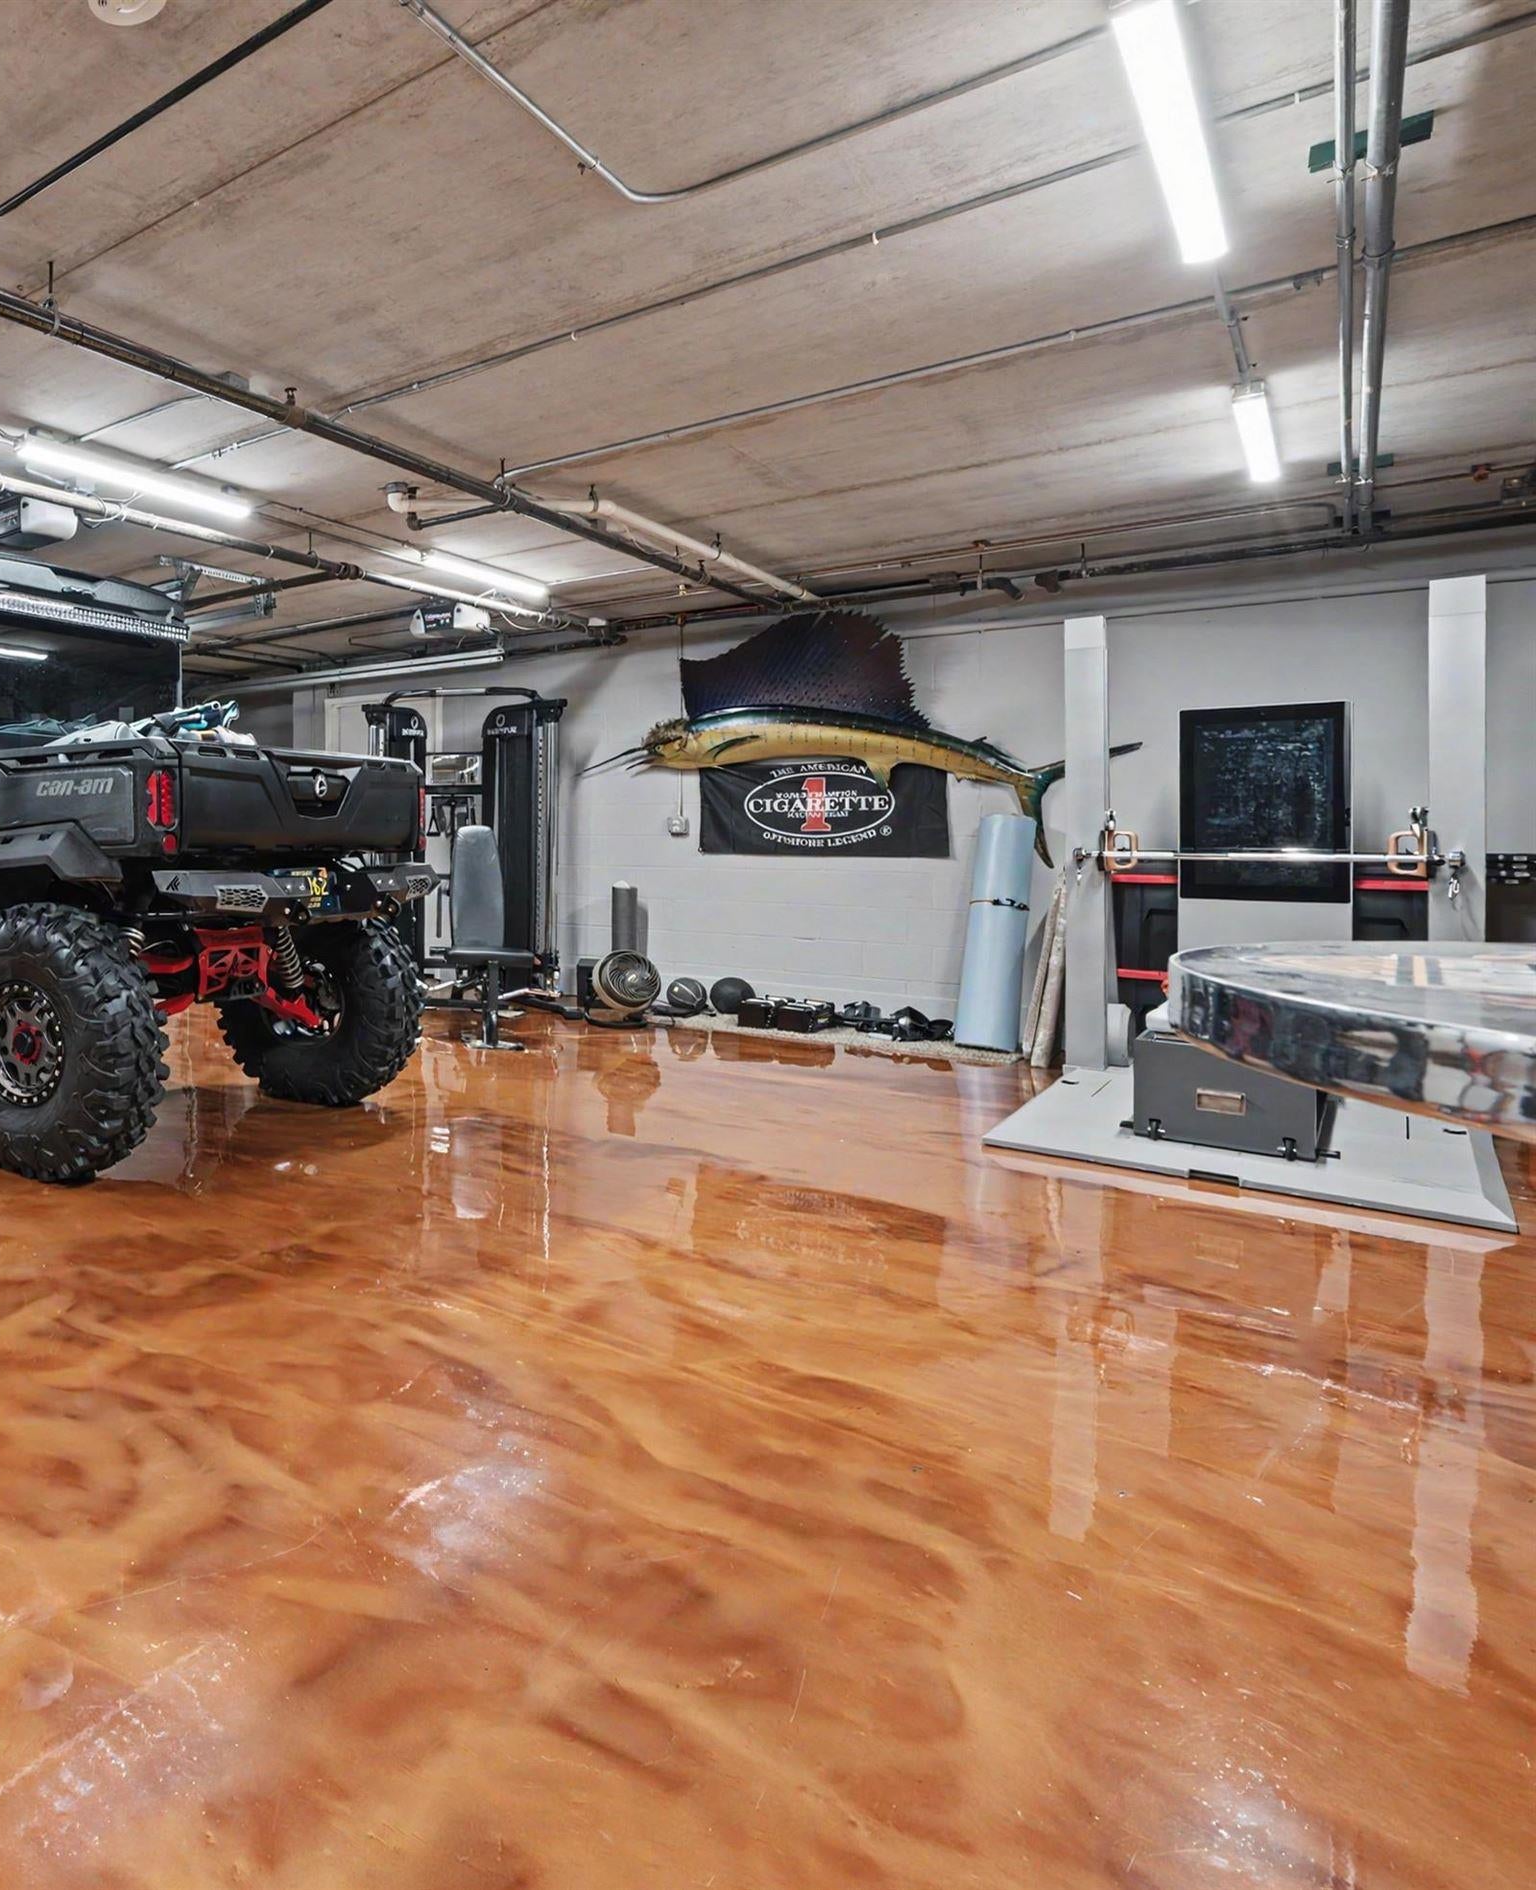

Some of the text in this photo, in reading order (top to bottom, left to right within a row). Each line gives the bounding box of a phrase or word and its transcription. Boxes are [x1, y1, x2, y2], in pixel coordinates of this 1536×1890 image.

[800, 763, 868, 774] AMERICAN
[36, 777, 114, 797] can-am
[748, 795, 890, 813] CIGARETTE
[763, 829, 876, 847] OFFSHORE LEGEND
